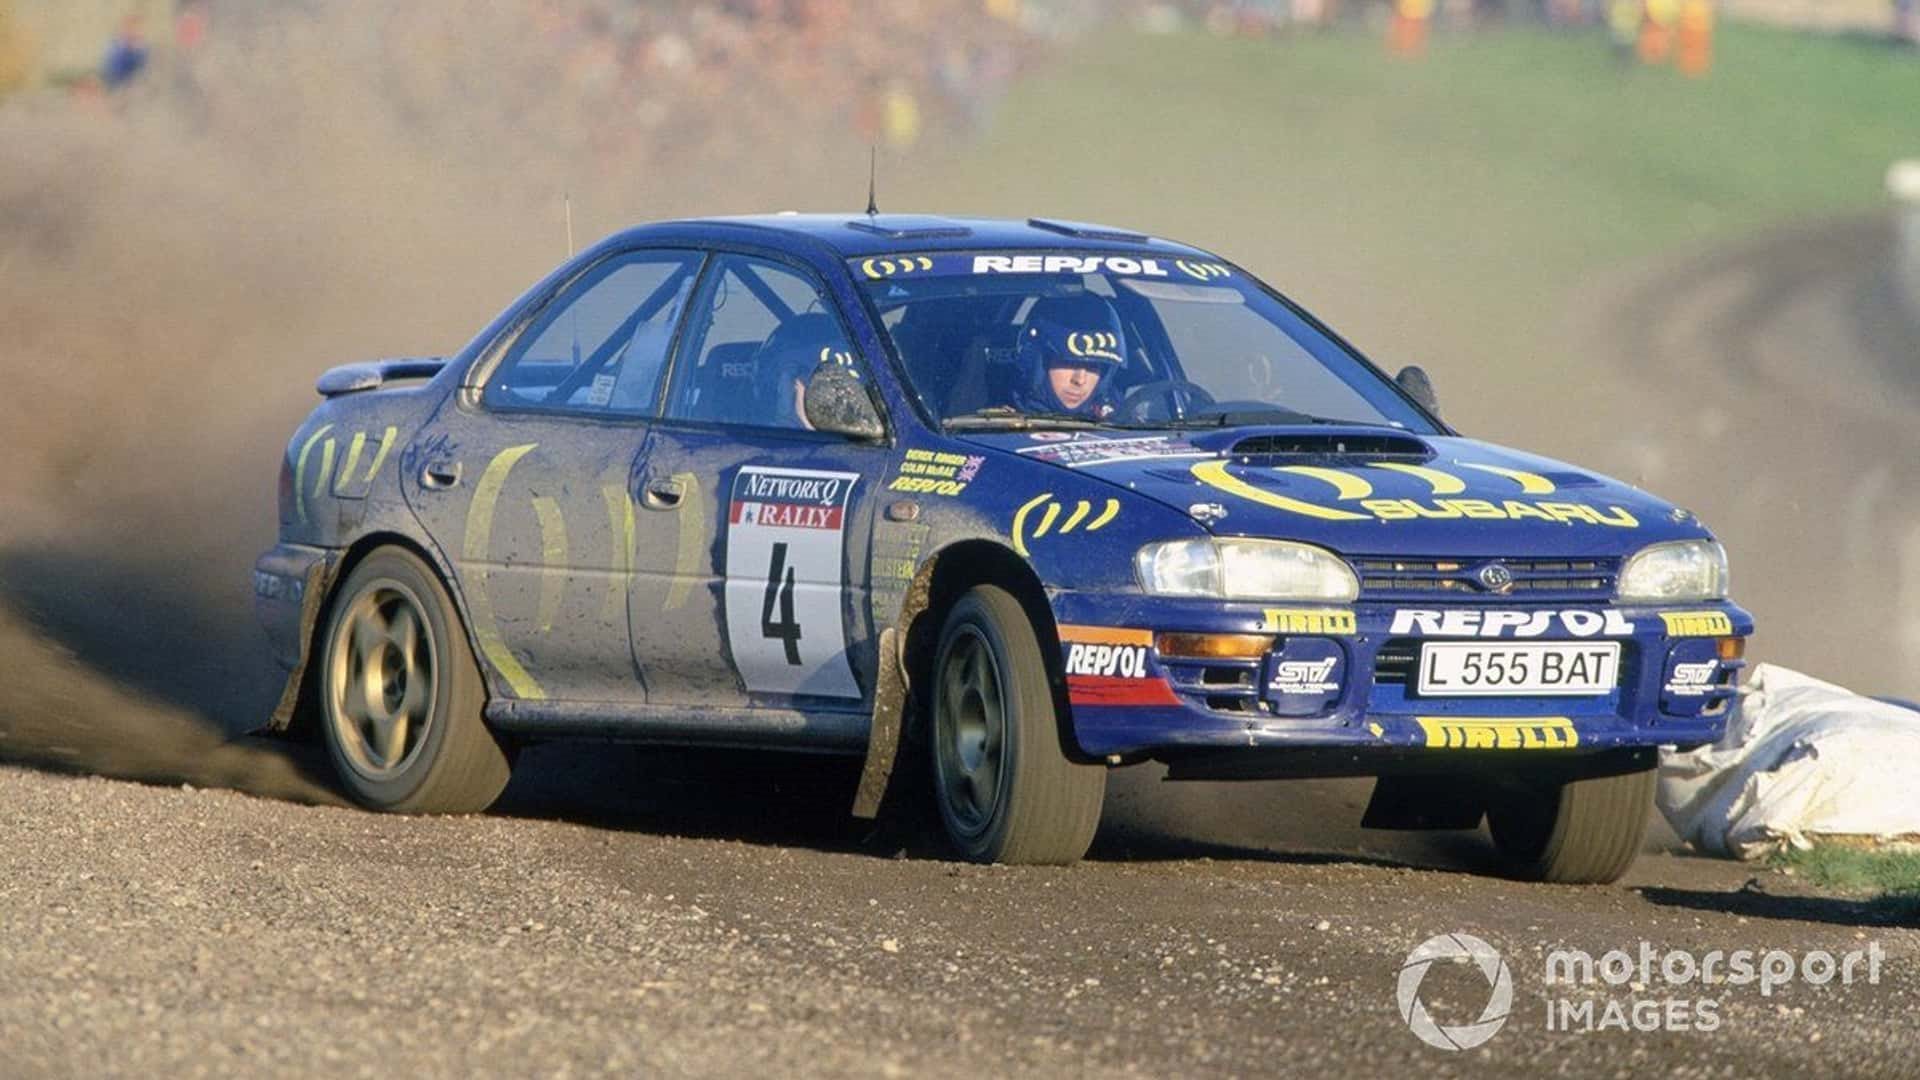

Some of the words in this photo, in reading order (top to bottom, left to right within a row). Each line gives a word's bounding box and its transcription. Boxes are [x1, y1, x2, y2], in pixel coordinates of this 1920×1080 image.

[972, 255, 1168, 276] REPSOL
[888, 476, 967, 496] REPSOL
[762, 504, 832, 528] RALLY
[1361, 499, 1639, 527] SUBARU
[761, 542, 803, 666] 4
[1263, 608, 1357, 635] PIRELLI
[1390, 608, 1636, 637] REPSOL
[1658, 610, 1734, 637] PIRELLI
[1065, 644, 1147, 678] REPSOL
[1428, 652, 1448, 684] L
[1461, 652, 1529, 685] 555
[1540, 652, 1611, 684] BAT
[1416, 716, 1580, 748] PIRELLI
